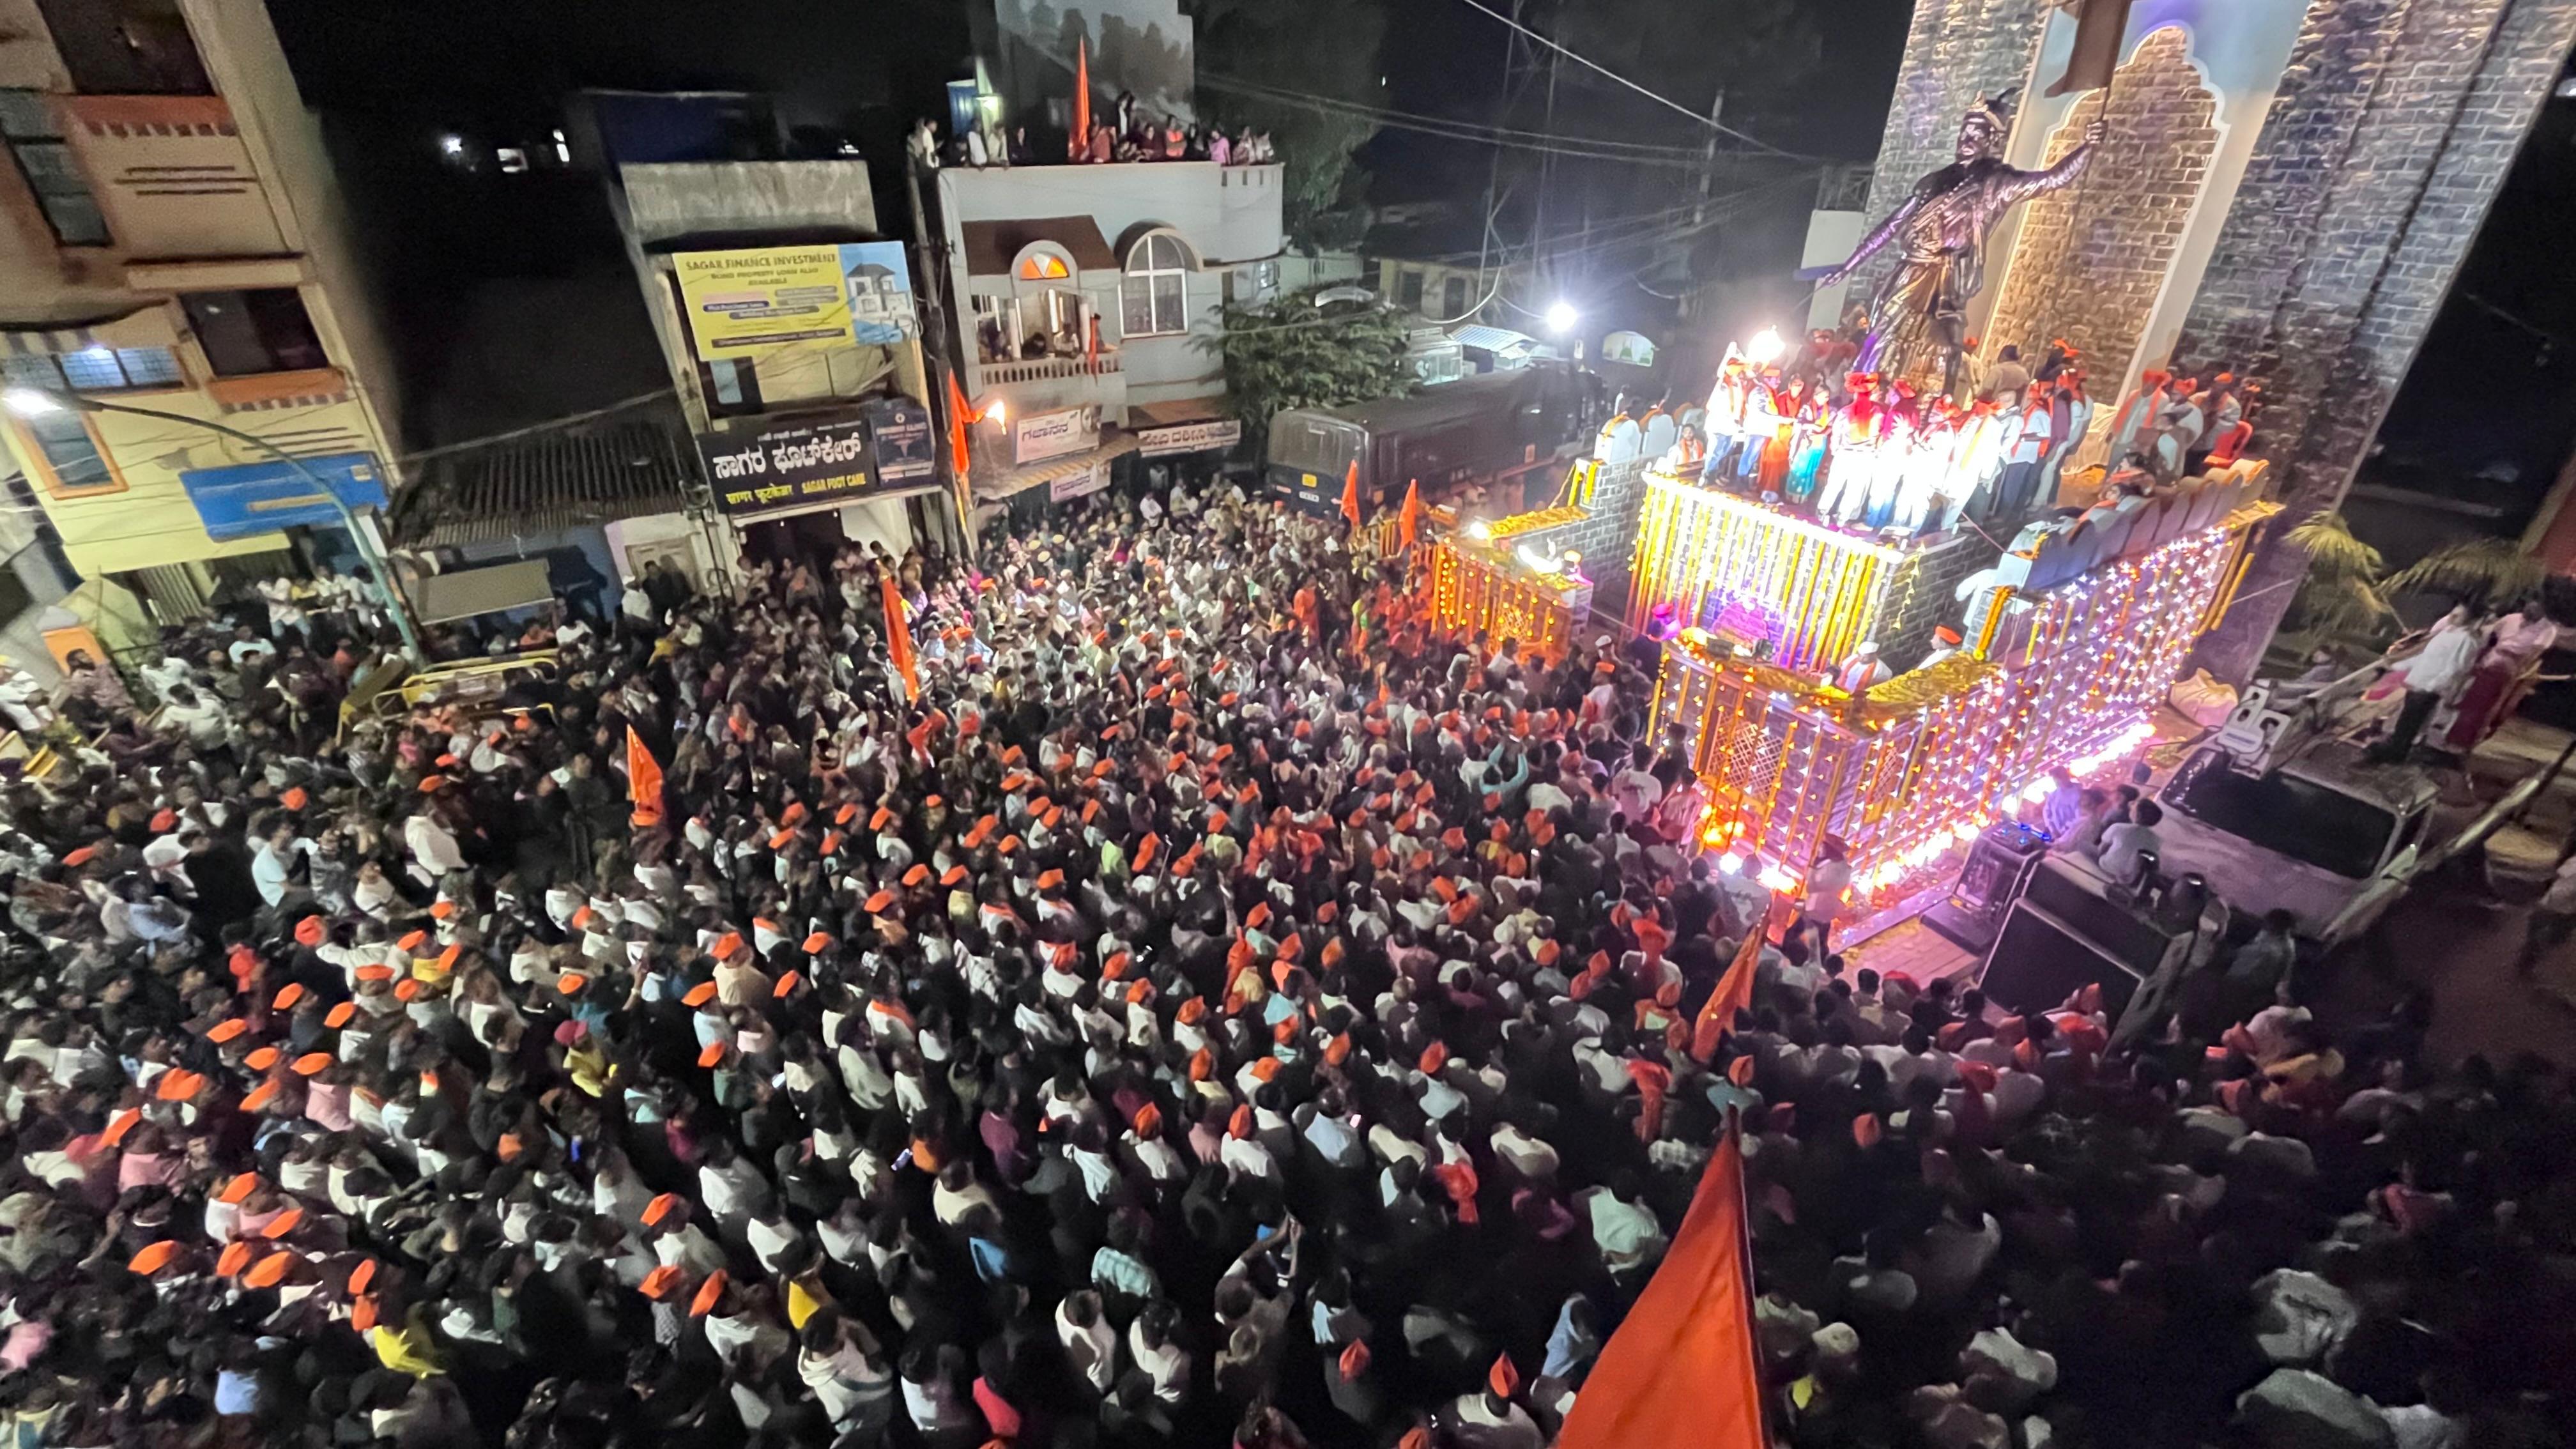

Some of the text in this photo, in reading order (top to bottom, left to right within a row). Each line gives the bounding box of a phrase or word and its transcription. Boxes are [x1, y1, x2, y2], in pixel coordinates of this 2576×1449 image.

[686, 254, 836, 271] SAGAR FINANCE INVESTMENT
[713, 445, 766, 479] ಸಾಗರ
[801, 473, 866, 494] SAGAR FOOT CARE
